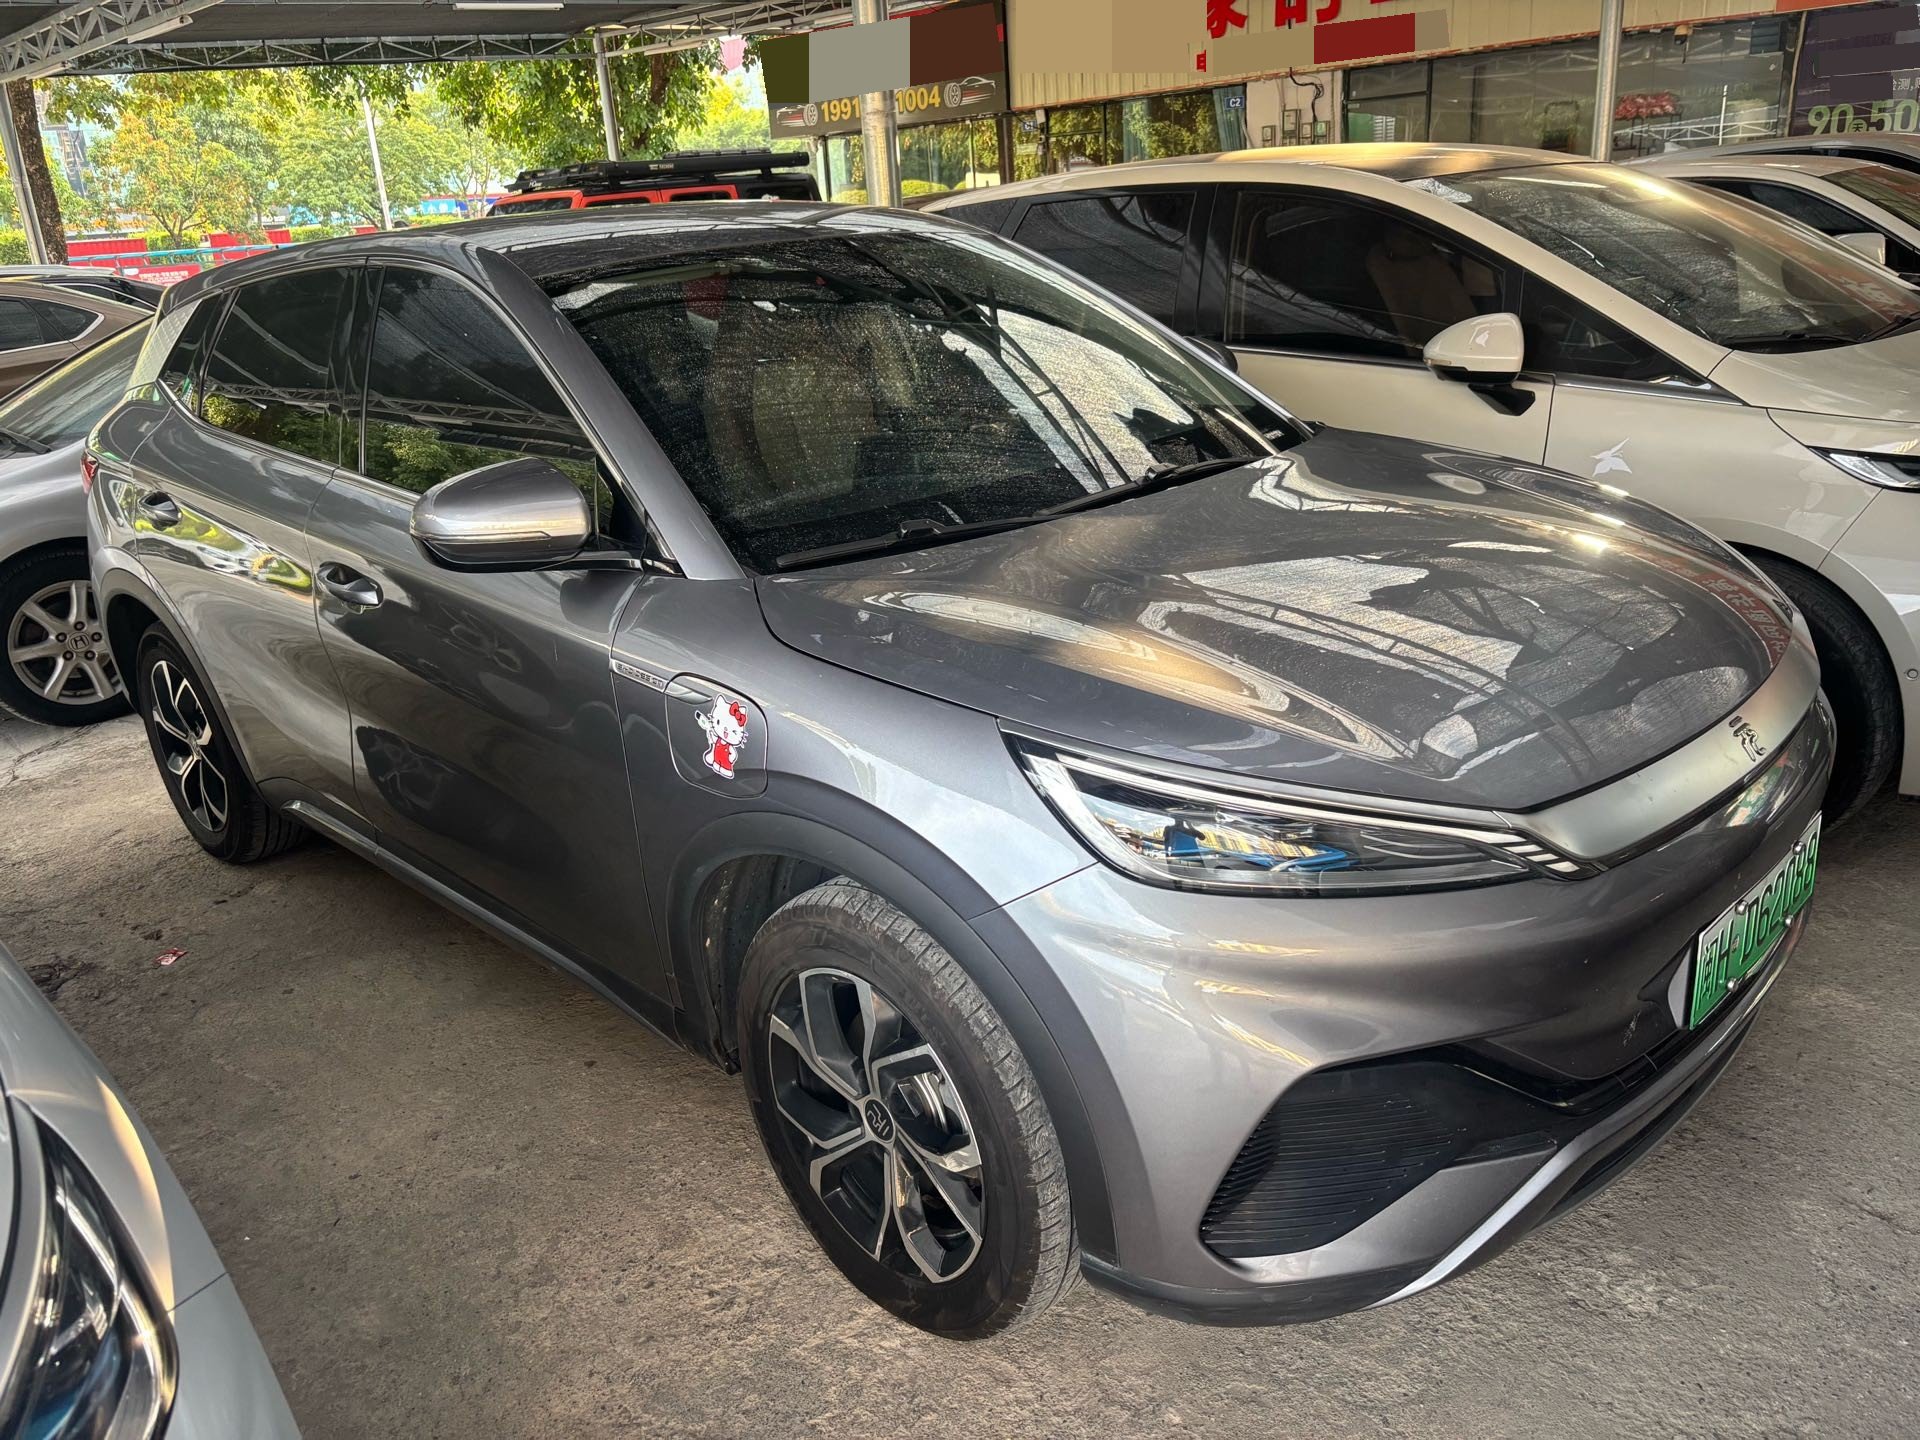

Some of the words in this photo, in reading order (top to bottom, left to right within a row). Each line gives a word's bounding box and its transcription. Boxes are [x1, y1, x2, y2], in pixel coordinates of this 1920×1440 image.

[821, 96, 860, 122] 1991
[896, 85, 941, 113] 1004
[1229, 98, 1241, 108] C2
